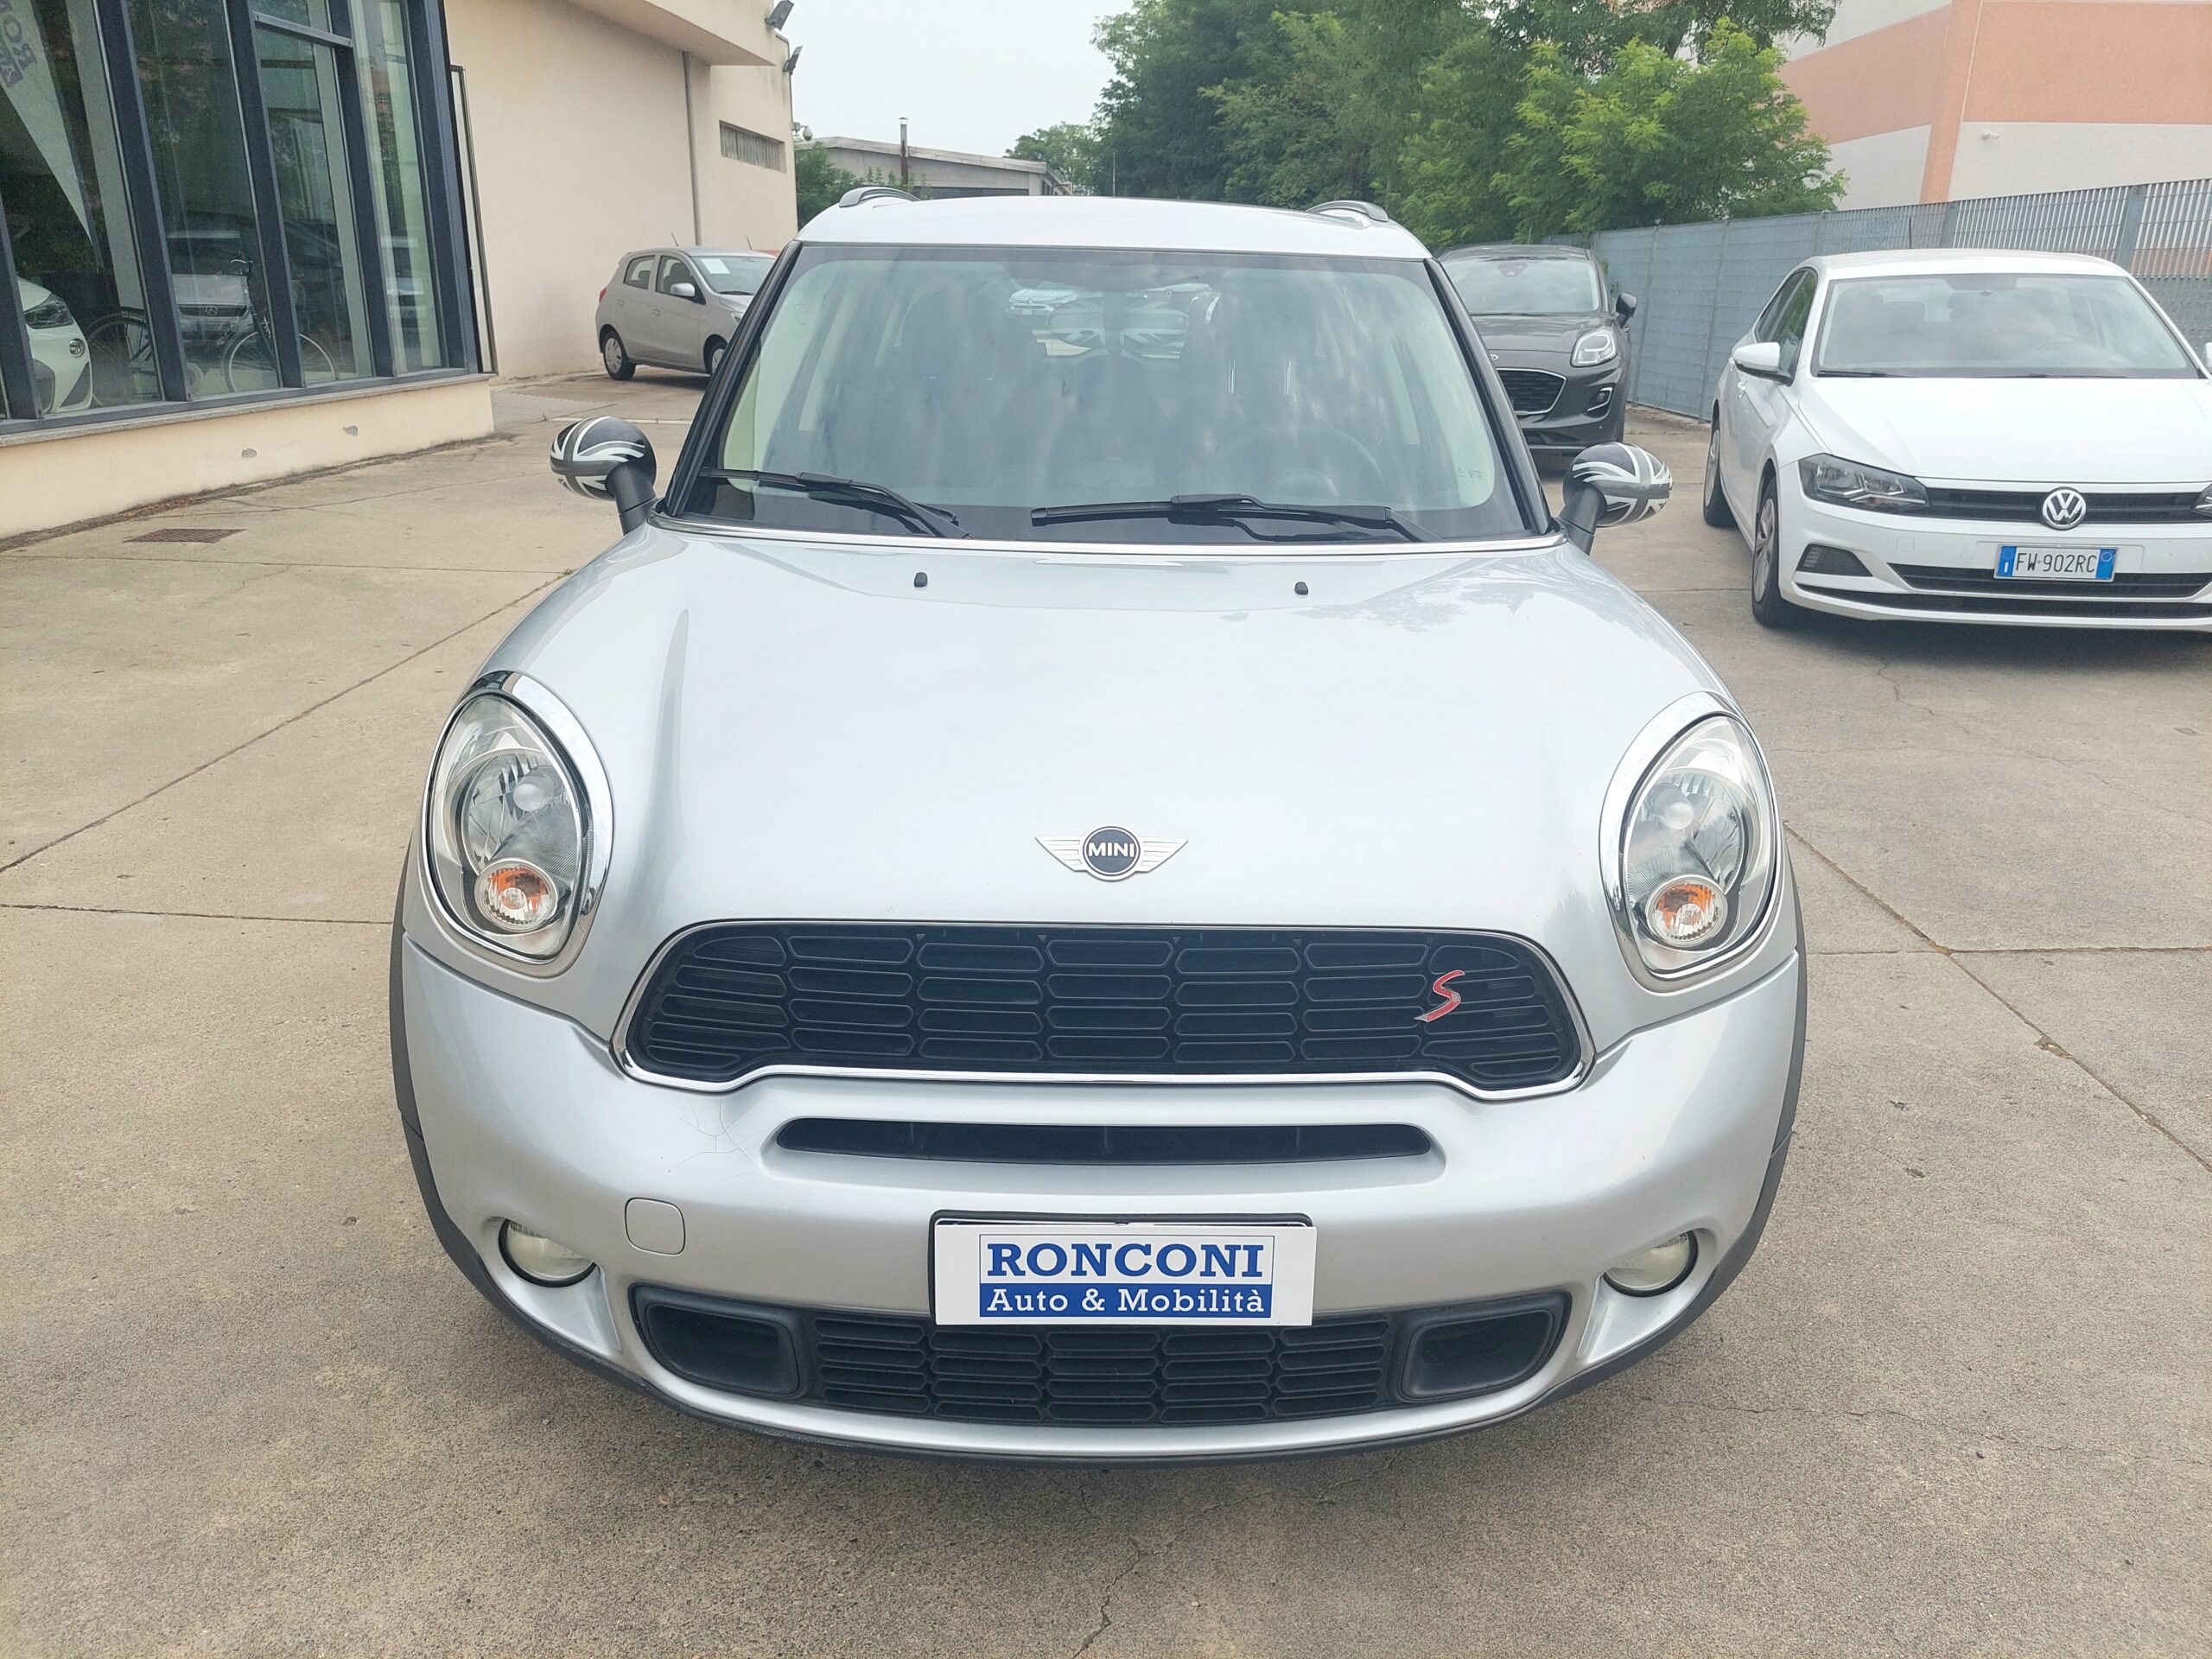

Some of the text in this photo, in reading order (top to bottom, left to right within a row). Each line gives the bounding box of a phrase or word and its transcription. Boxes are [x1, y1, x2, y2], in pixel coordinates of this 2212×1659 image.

[1088, 842, 1135, 858] MINI
[1414, 969, 1466, 1023] S
[987, 1243, 1264, 1277] RONCONI
[986, 1287, 1265, 1313] Auto & Mobilità
